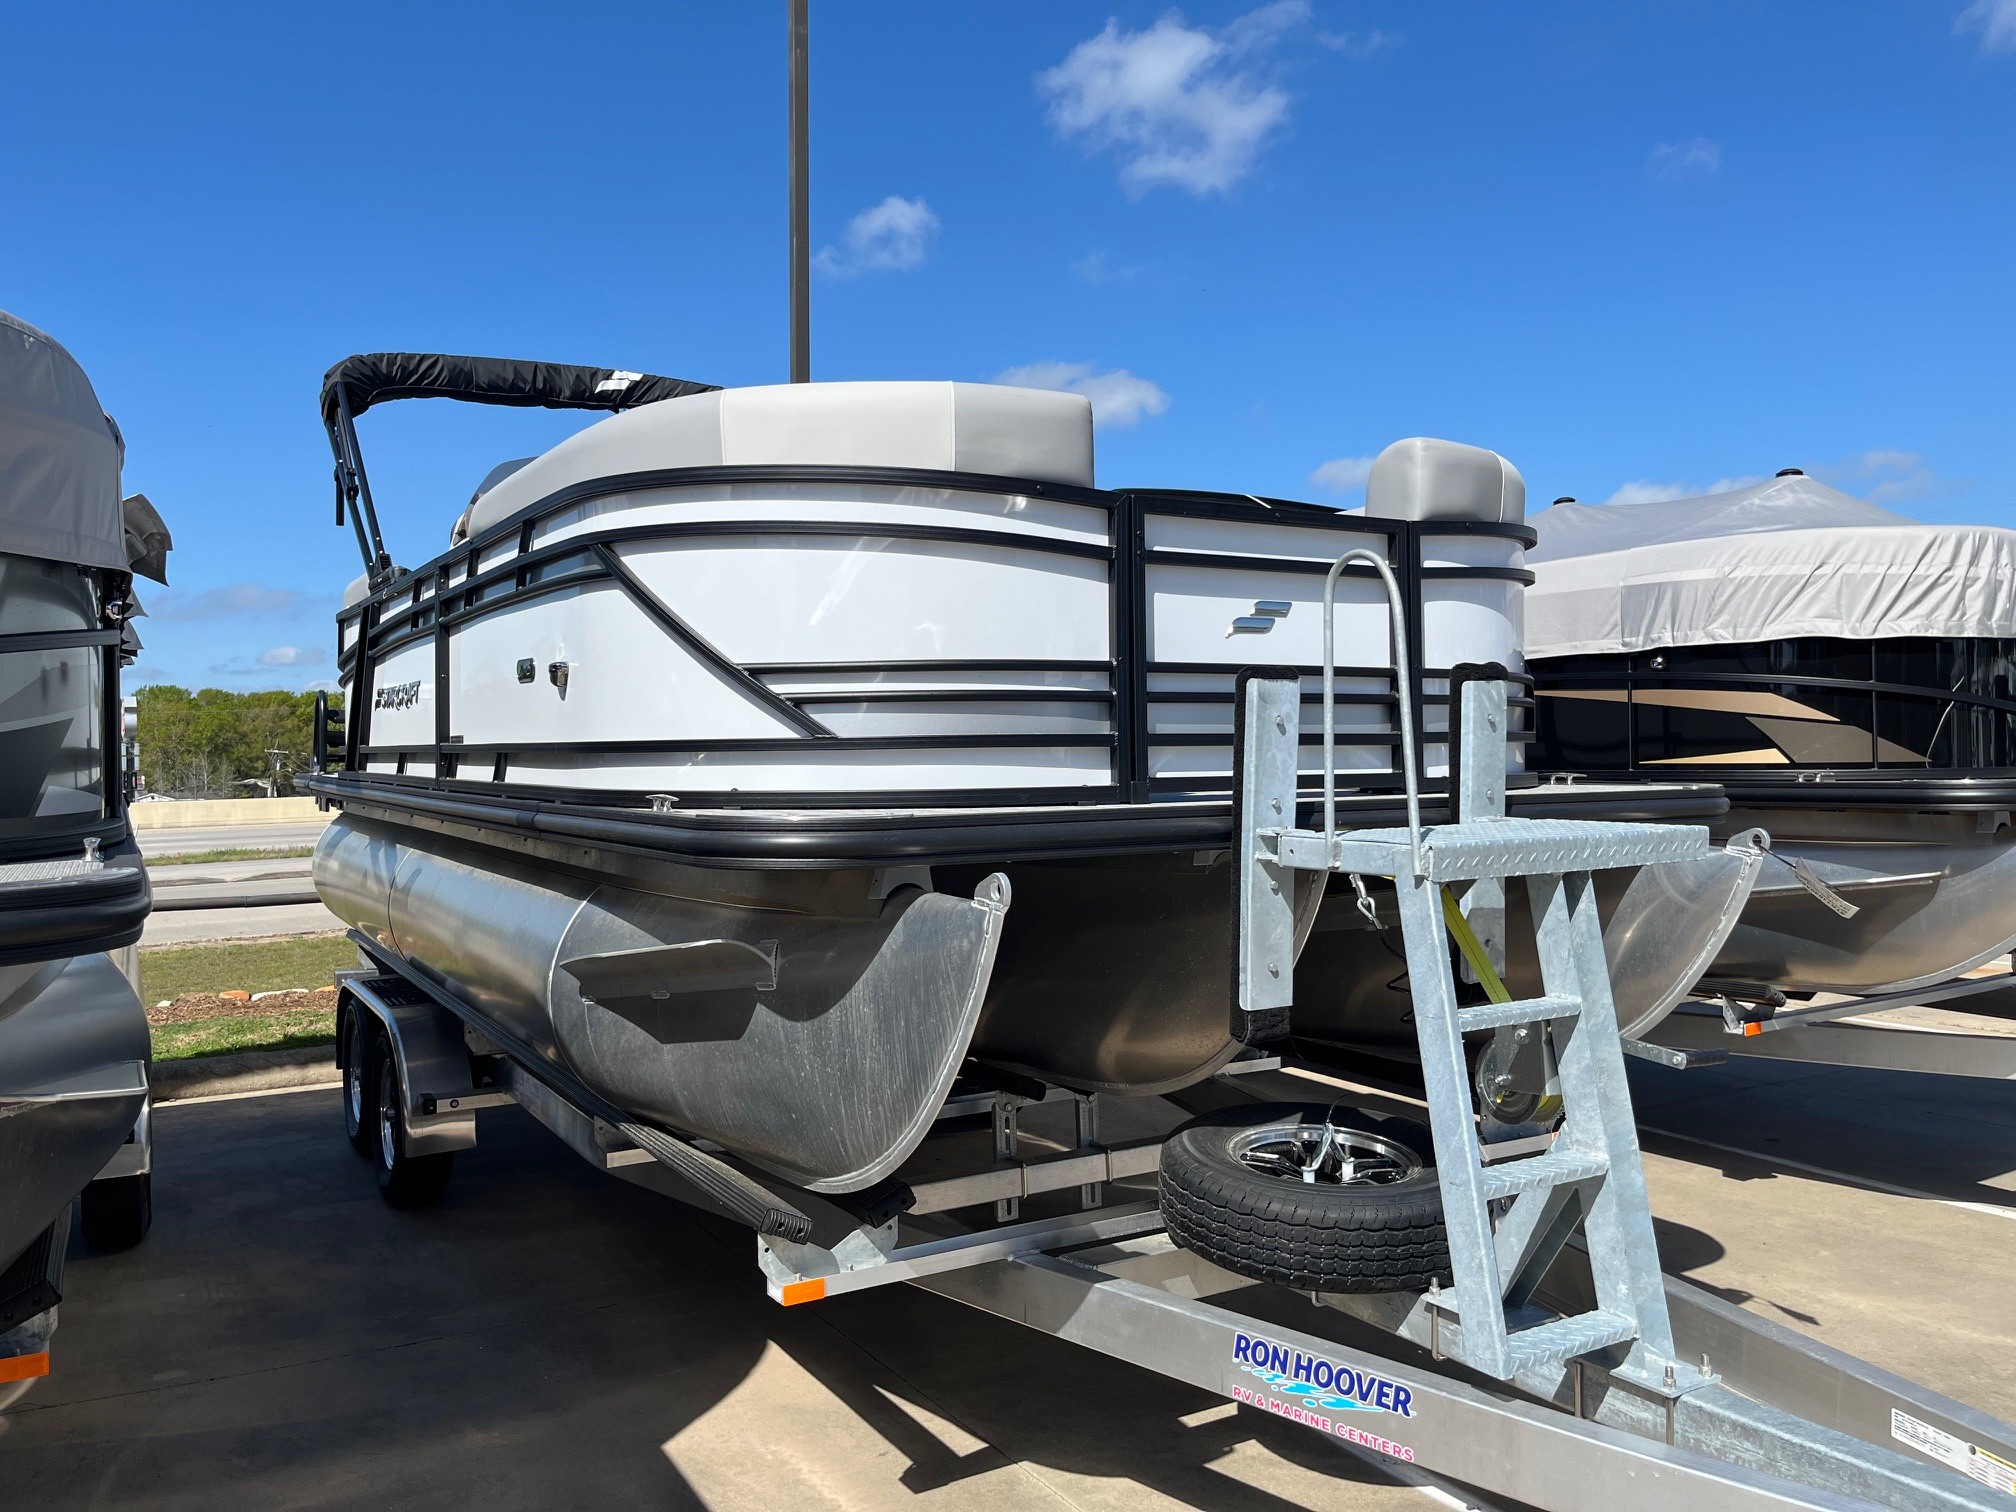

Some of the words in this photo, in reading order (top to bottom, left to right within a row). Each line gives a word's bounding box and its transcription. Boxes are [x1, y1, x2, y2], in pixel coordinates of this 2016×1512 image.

[1233, 1332, 1290, 1376] RON
[1293, 1352, 1413, 1418] HOOVER
[1233, 1385, 1251, 1402] RV
[1256, 1394, 1265, 1408] &
[1269, 1398, 1331, 1432] MARINE
[1336, 1424, 1414, 1462] CENTERS
